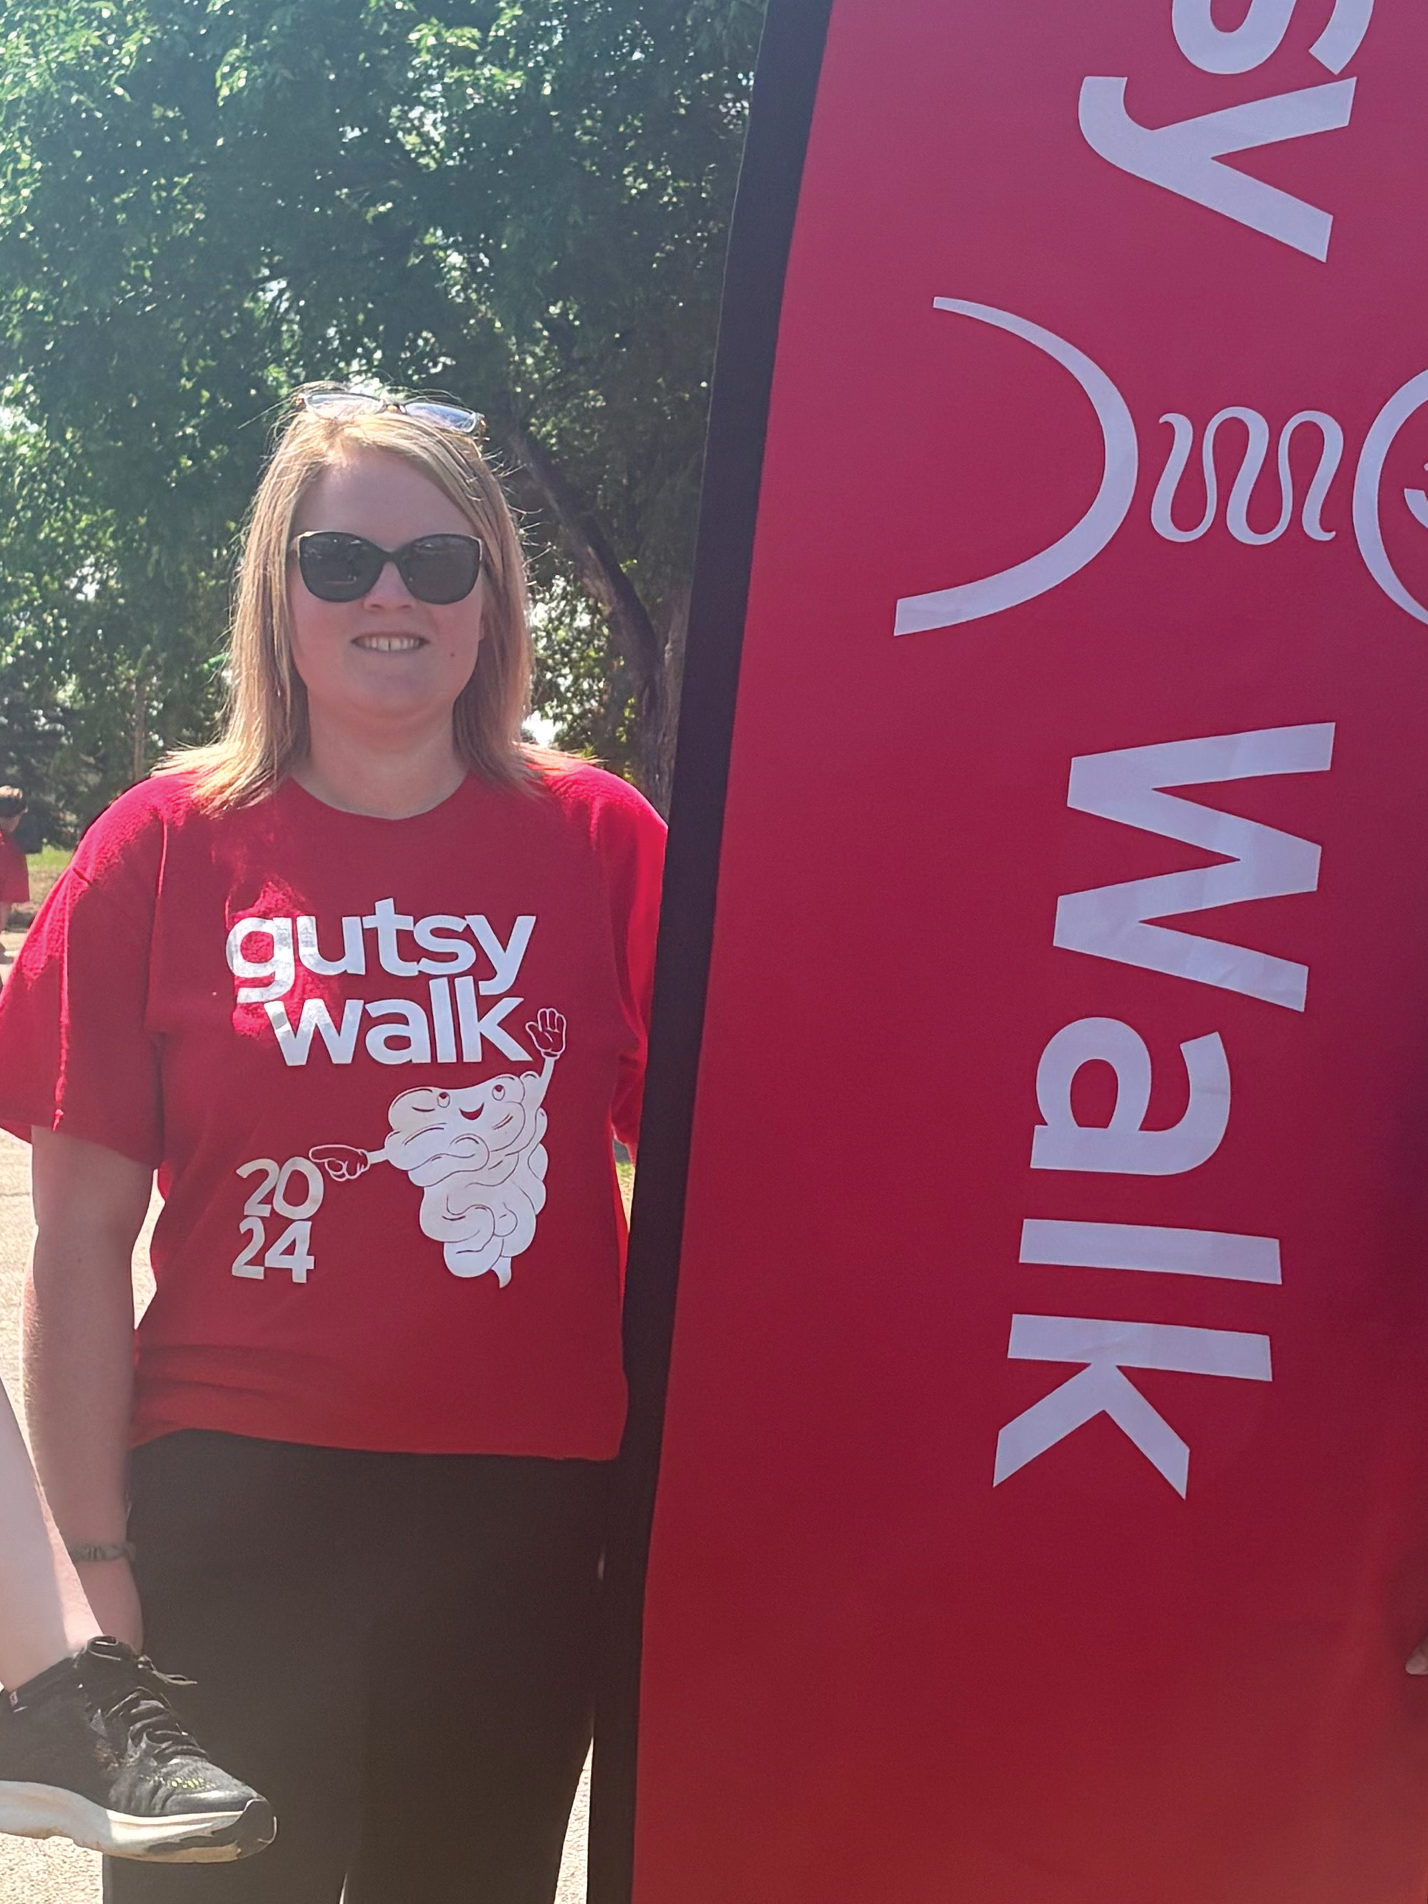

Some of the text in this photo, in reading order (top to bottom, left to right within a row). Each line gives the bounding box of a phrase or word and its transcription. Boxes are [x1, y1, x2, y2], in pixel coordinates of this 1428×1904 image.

[226, 898, 536, 1004] gutsy
[264, 976, 532, 1066] walk
[994, 723, 1335, 1498] Walk
[236, 1157, 324, 1220] 20
[232, 1217, 314, 1284] 24
